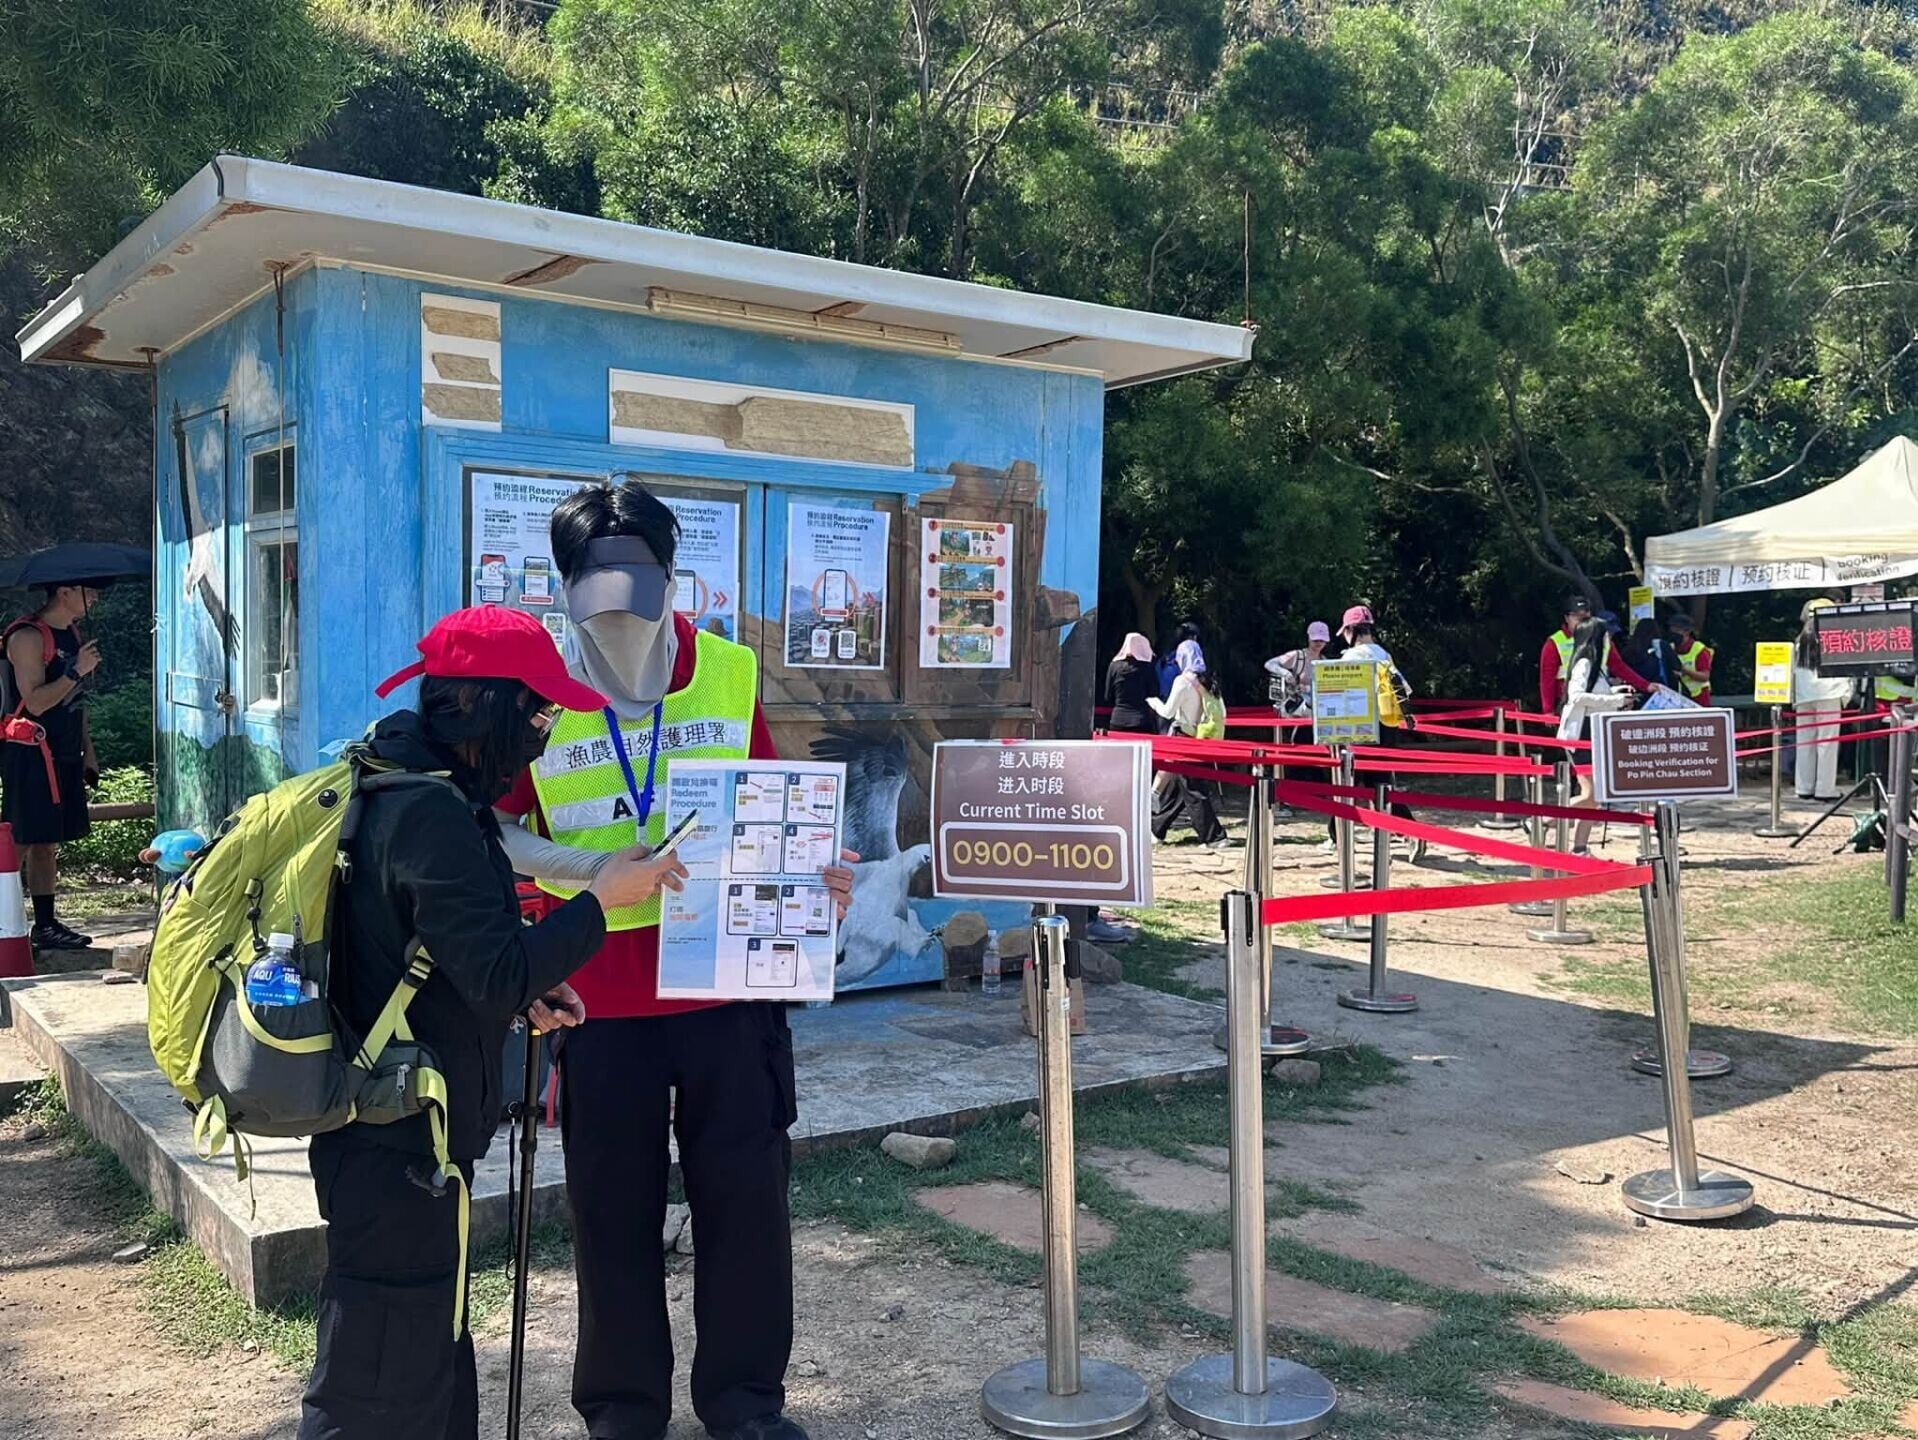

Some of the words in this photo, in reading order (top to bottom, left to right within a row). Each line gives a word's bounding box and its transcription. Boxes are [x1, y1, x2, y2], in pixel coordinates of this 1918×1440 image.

[529, 485, 578, 497] Reservati
[529, 494, 562, 504] Proced
[675, 505, 722, 516] Reservation
[676, 513, 716, 523] Procedure
[833, 513, 874, 524] Reservation
[834, 521, 868, 530] Procedure
[1742, 561, 1811, 585] 预约核证
[1818, 625, 1913, 654] 預約核證
[565, 722, 727, 769] 漁農自然護理署
[998, 751, 1066, 769] 進入時段
[1618, 759, 1653, 769] Booking
[1654, 757, 1704, 768] Verification
[1705, 756, 1719, 766] for
[1627, 770, 1639, 779] Po
[1640, 769, 1654, 779] Pin
[1656, 768, 1678, 778] Chau
[1679, 767, 1712, 778] Section
[997, 776, 1065, 795] 进入时段
[672, 788, 708, 797] Redeem
[671, 799, 717, 808] Procedure
[959, 802, 1021, 818] Current
[1025, 803, 1067, 819] Time
[1070, 803, 1105, 820] Slot
[952, 840, 1114, 870] 0900-1100
